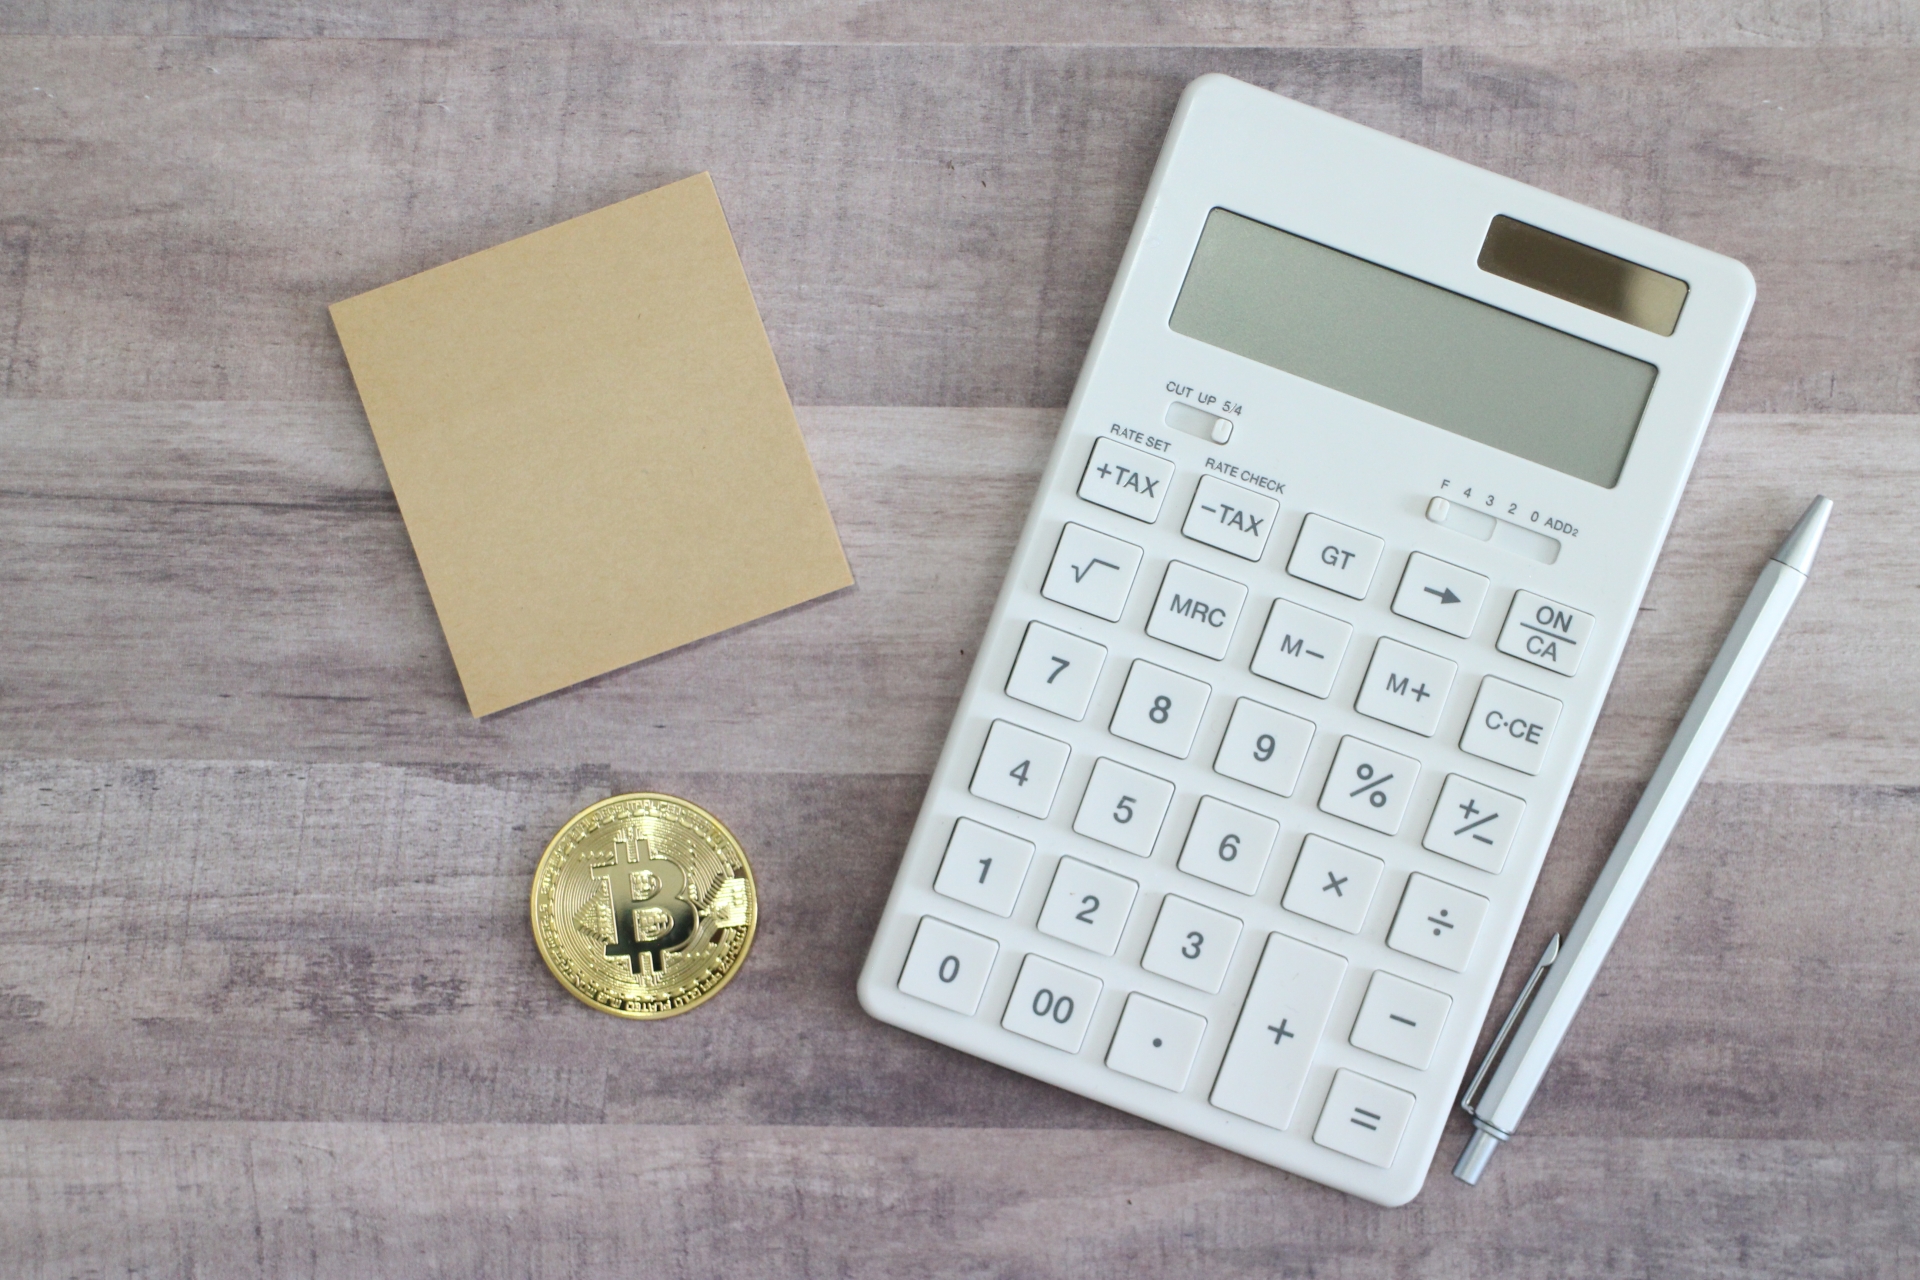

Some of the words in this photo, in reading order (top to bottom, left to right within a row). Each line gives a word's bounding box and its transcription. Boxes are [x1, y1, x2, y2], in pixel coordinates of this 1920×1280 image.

[1166, 381, 1194, 398] CUT
[1198, 391, 1217, 406] UP
[1222, 401, 1243, 416] 5/4
[1110, 423, 1144, 444] RATE
[1145, 436, 1172, 453] SET
[1096, 462, 1160, 499] +TAX
[1205, 457, 1238, 478] RATE
[1240, 469, 1287, 495] CHECK
[1441, 479, 1451, 490] F
[1464, 488, 1472, 499] 4
[1485, 495, 1495, 507] 3
[1507, 503, 1518, 514] 2
[1530, 511, 1540, 523] 0
[1320, 545, 1357, 570] GT
[1169, 593, 1227, 628] MRC
[1536, 605, 1573, 634] ON
[1526, 635, 1559, 662] CA
[1047, 655, 1071, 685] 7
[1386, 672, 1431, 704] M+
[1149, 694, 1173, 725] 8
[1252, 733, 1276, 763] 9
[1008, 759, 1031, 787] 4
[1349, 762, 1395, 809] %
[1112, 795, 1137, 825] 5
[1218, 833, 1242, 863] 6
[979, 858, 993, 885] 1
[1075, 894, 1101, 925] 2
[1181, 930, 1205, 960] 3
[939, 954, 961, 984] 0
[1031, 987, 1075, 1025] 00
